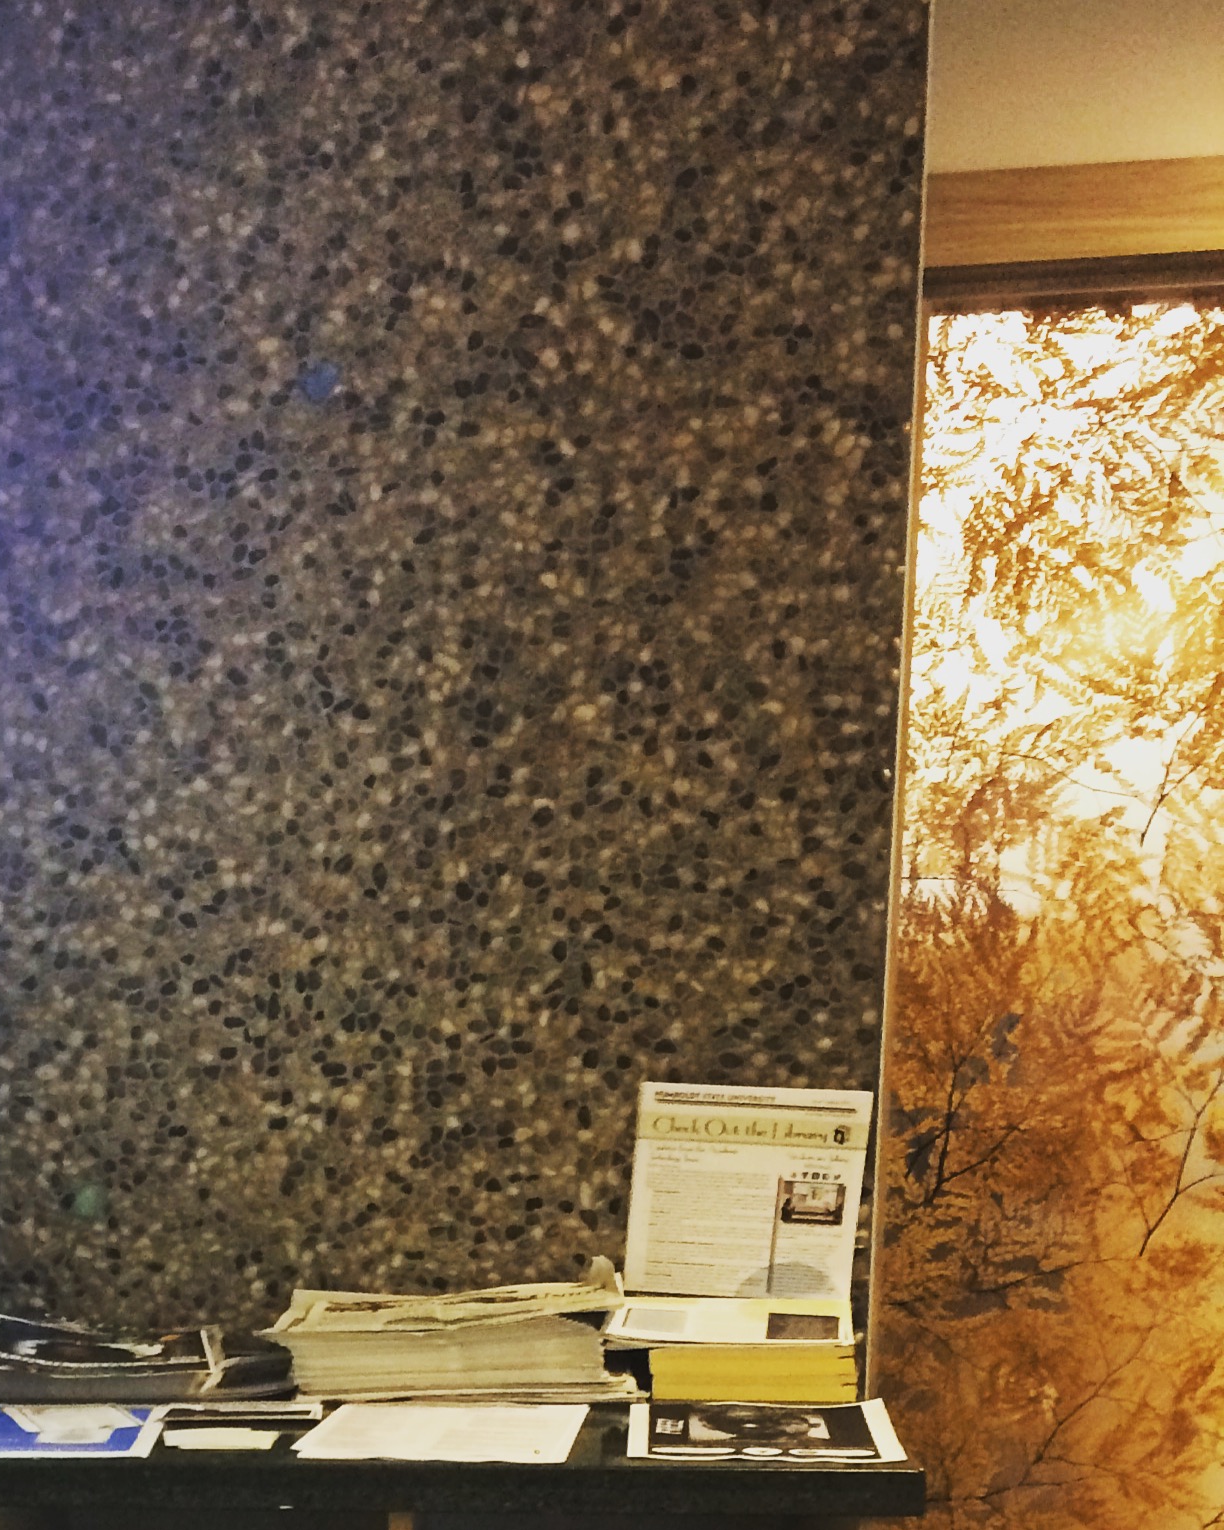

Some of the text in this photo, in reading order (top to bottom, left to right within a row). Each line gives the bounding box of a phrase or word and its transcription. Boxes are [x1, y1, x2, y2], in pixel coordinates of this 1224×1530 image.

[652, 1116, 699, 1135] Check
[704, 1118, 739, 1137] Out
[746, 1120, 768, 1137] the
